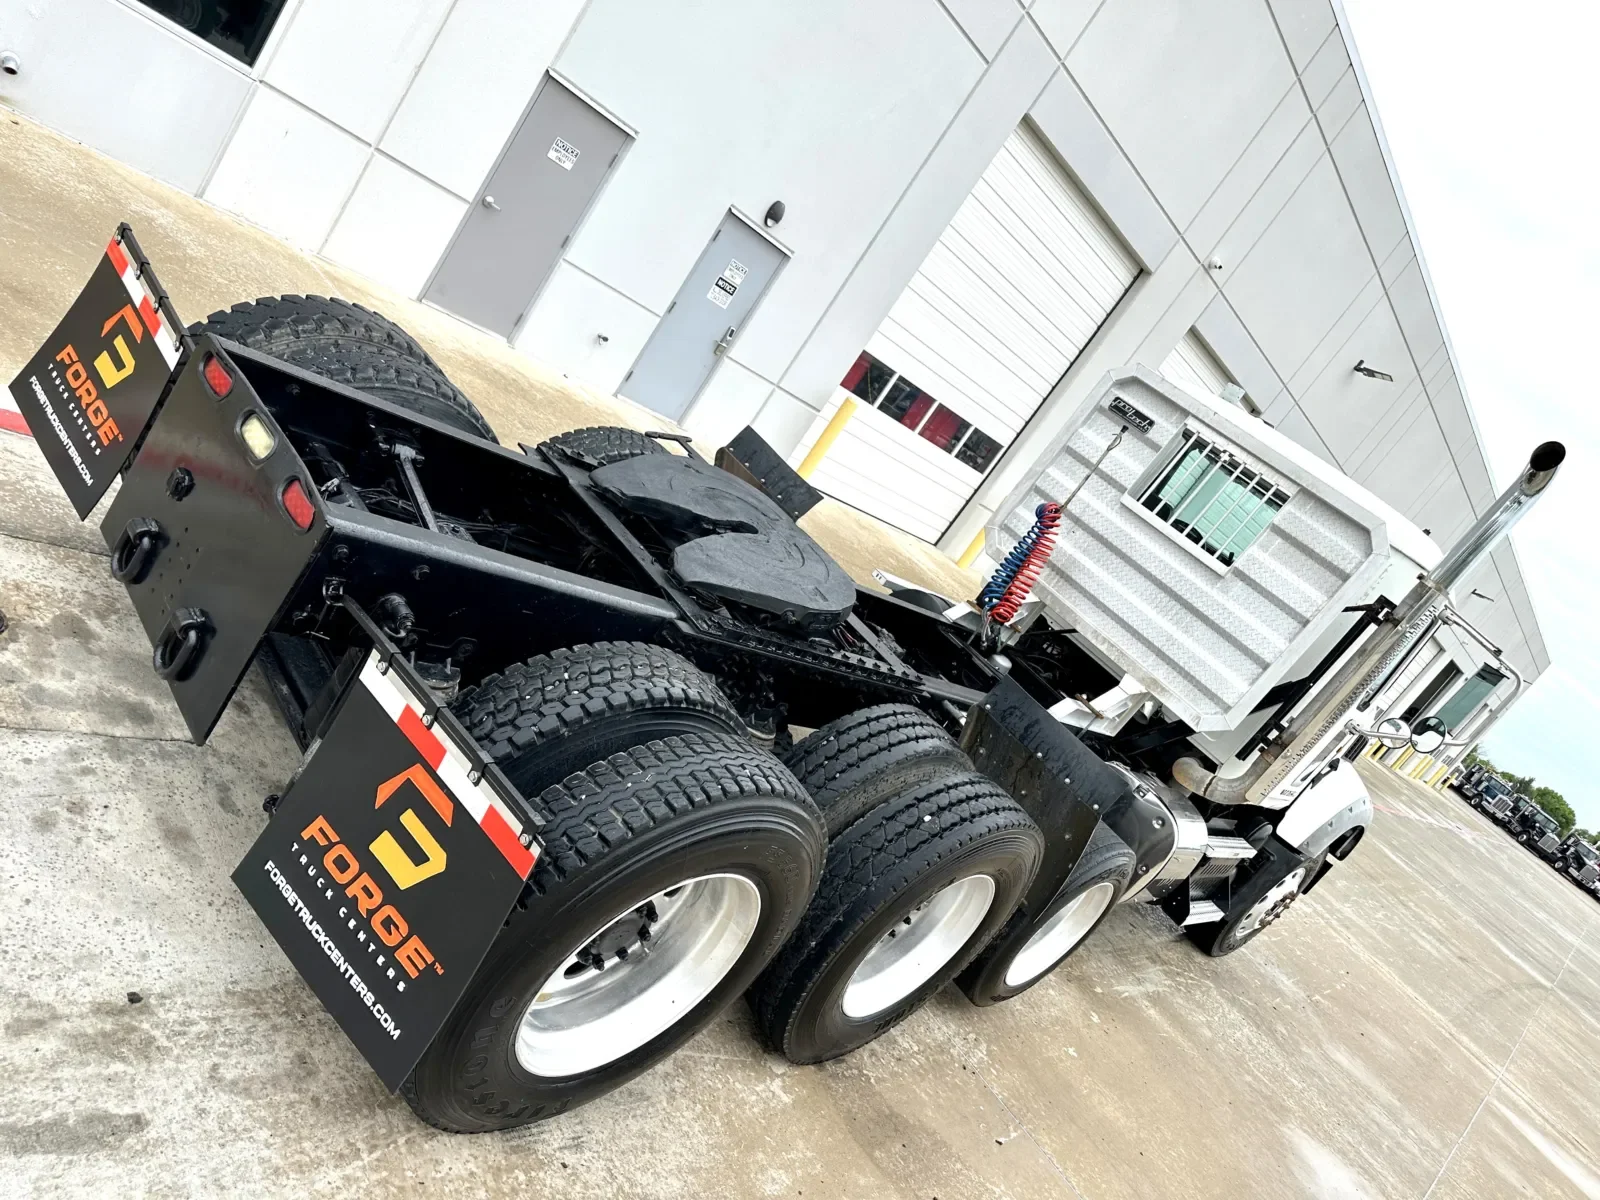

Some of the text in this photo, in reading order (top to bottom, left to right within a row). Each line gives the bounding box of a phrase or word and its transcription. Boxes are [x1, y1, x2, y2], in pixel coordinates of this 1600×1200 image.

[555, 139, 580, 158] NOTICE
[717, 279, 737, 294] NOTICE
[29, 375, 93, 487] FORGETRUCKCENTERS.COM
[47, 362, 101, 456] TRUCK CENTERS
[55, 343, 120, 447] FORGE
[263, 859, 401, 1040] FORGETRUCKCENTERS.COM
[291, 841, 406, 992] TRUCK CENTERS
[300, 814, 435, 979] FORGE
